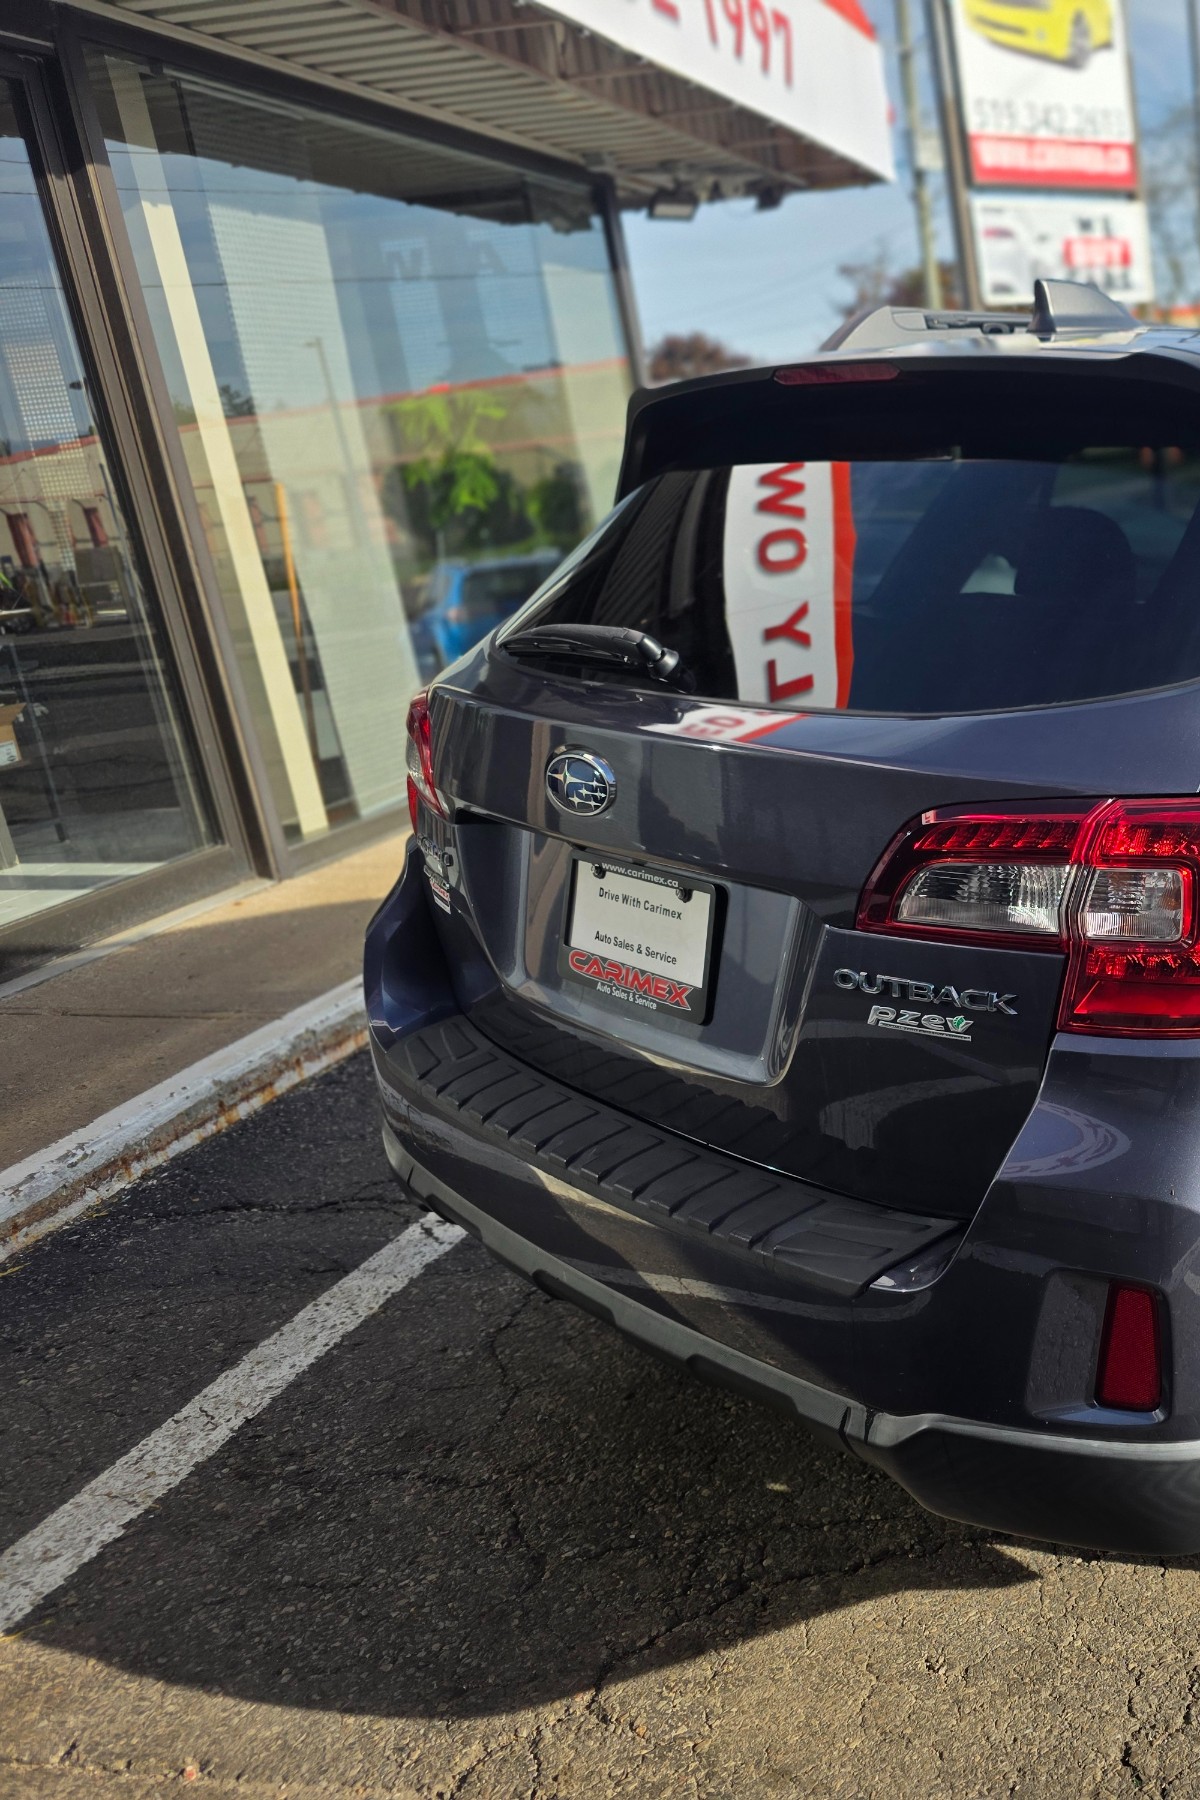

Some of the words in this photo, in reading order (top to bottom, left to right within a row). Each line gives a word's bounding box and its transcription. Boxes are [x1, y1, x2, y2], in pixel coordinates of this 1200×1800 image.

[703, 0, 794, 91] 1997
[602, 862, 679, 888] www.carimex.ca
[599, 886, 620, 903] Drive
[622, 893, 642, 909] With
[643, 899, 682, 920] Carimex
[594, 930, 612, 945] Auto
[613, 936, 634, 952] Sales
[636, 943, 643, 954] &
[645, 947, 677, 965] Service
[569, 949, 692, 1010] CARIMEX
[596, 981, 611, 994] Auto
[611, 986, 628, 1000] Sales
[628, 992, 634, 1002] &
[634, 994, 657, 1010] Service
[833, 968, 1019, 1015] OUTBACK
